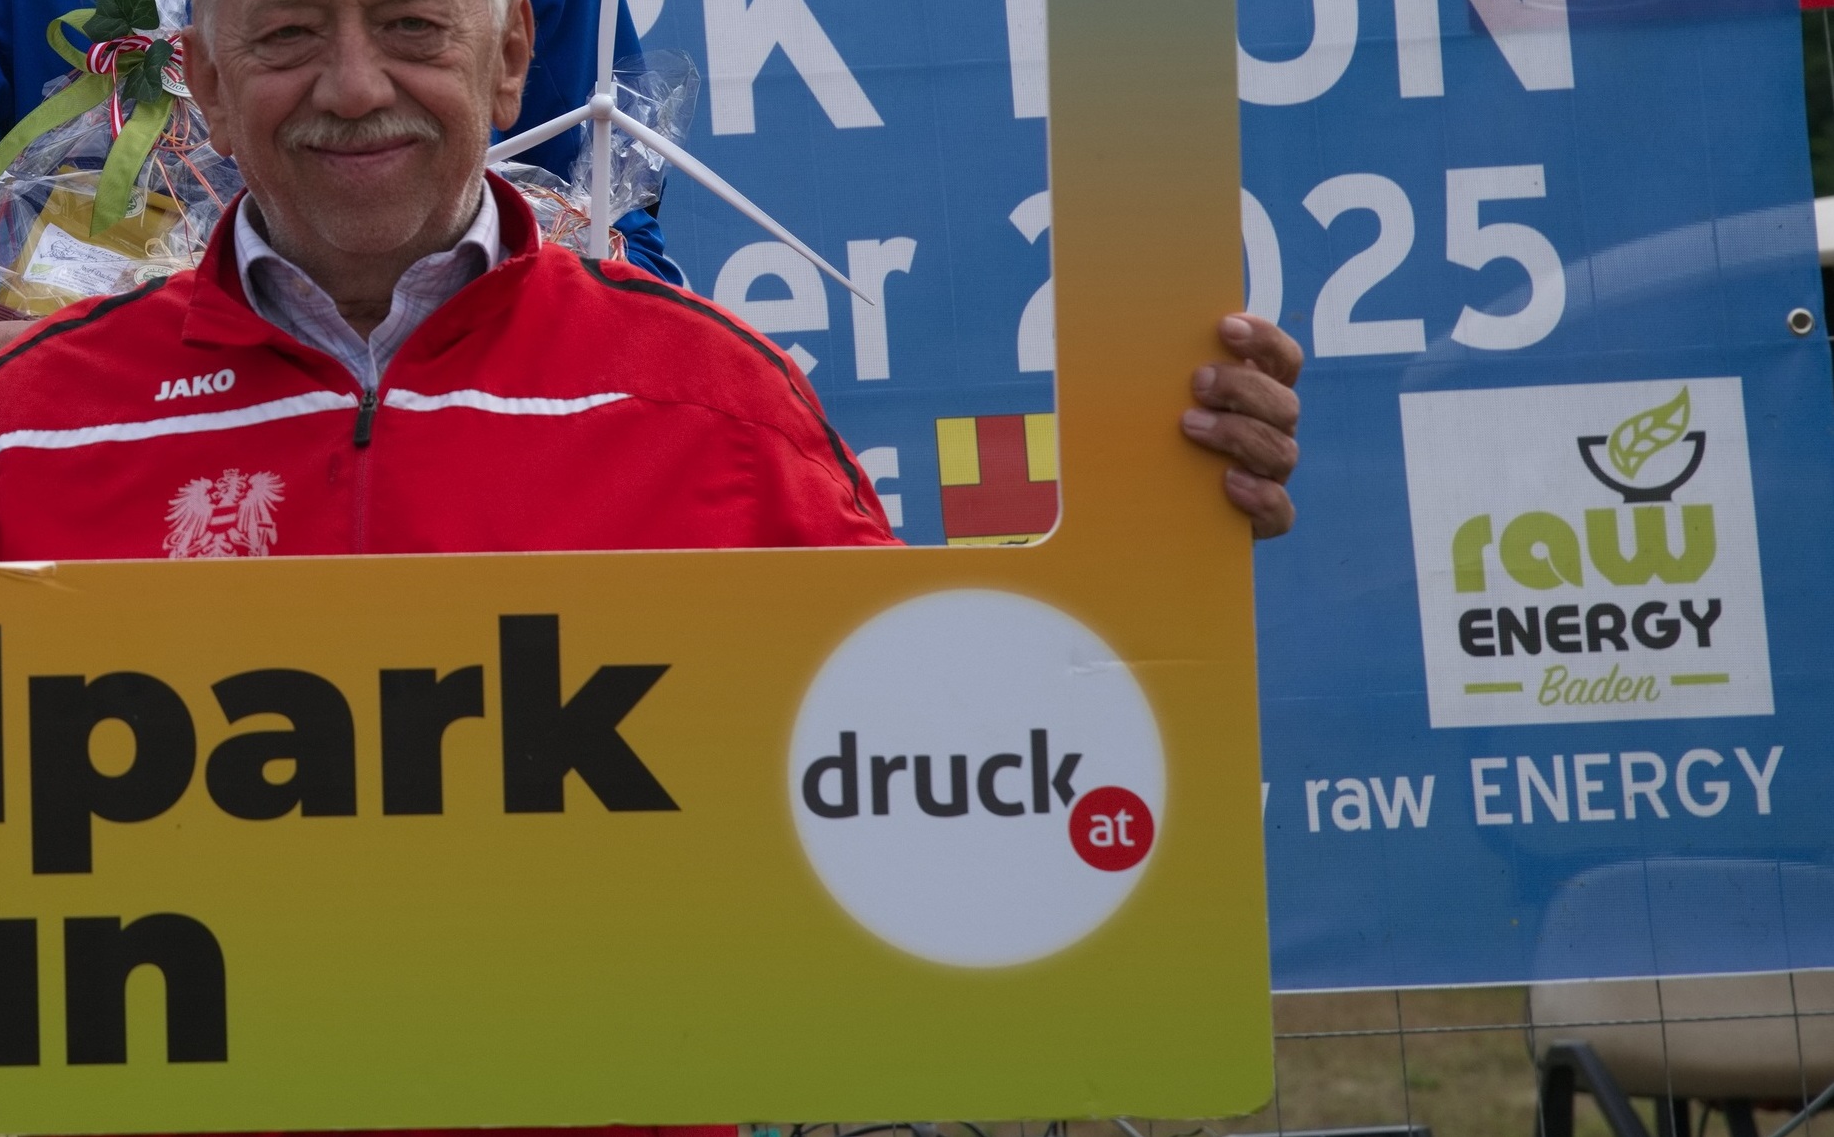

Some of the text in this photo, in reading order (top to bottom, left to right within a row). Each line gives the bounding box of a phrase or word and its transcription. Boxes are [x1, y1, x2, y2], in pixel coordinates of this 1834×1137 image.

[154, 368, 235, 402] JAKO
[1451, 504, 1717, 594] raw
[1457, 598, 1722, 657] ENERGY
[1537, 663, 1660, 707] Baden
[802, 728, 1136, 848] druck at
[1305, 774, 1435, 833] raw
[1471, 745, 1784, 826] ENERGY
